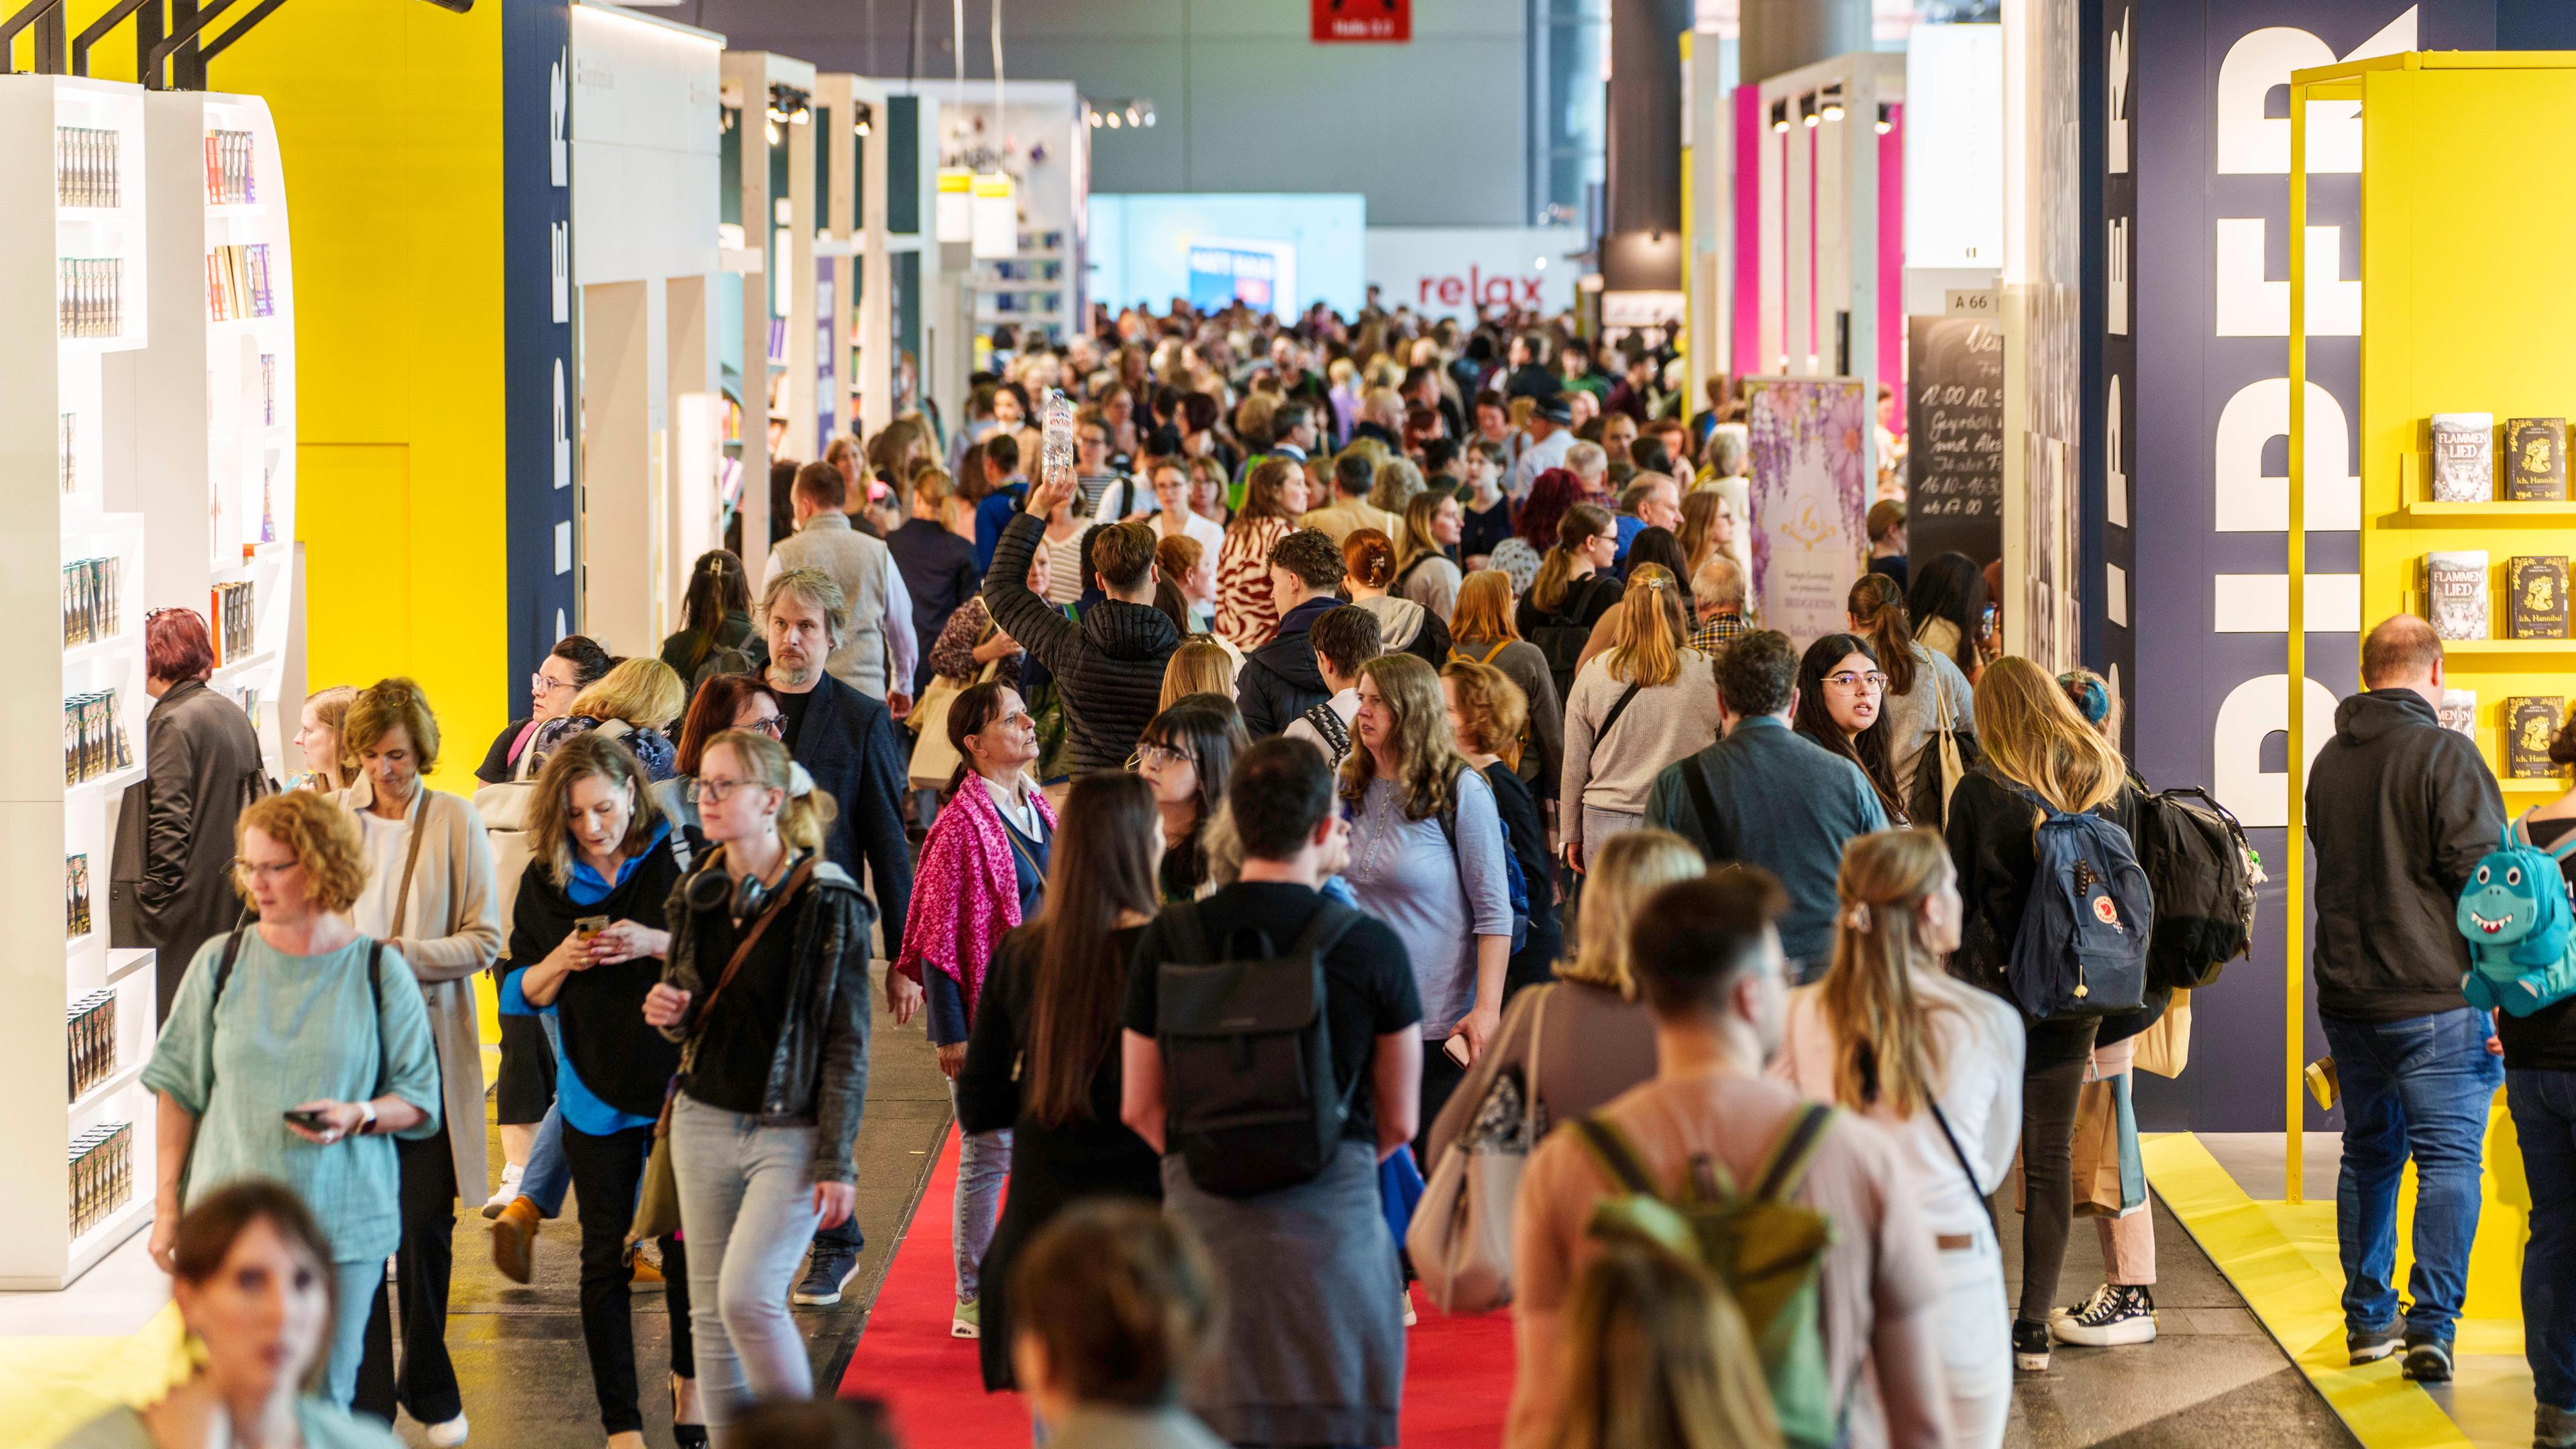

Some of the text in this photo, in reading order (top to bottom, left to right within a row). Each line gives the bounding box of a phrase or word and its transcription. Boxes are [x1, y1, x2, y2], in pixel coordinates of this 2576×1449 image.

[1418, 262, 1543, 306] relax
[1955, 296, 1987, 309] A 66
[549, 44, 572, 645] IPER
[2438, 432, 2487, 444] FLAMMEN
[2449, 444, 2477, 458] LIED
[2516, 476, 2560, 484] Ich, Hannibal
[2434, 570, 2482, 582] FLAMMEN
[2445, 583, 2473, 596] LIED
[2532, 614, 2563, 623] Hannibal
